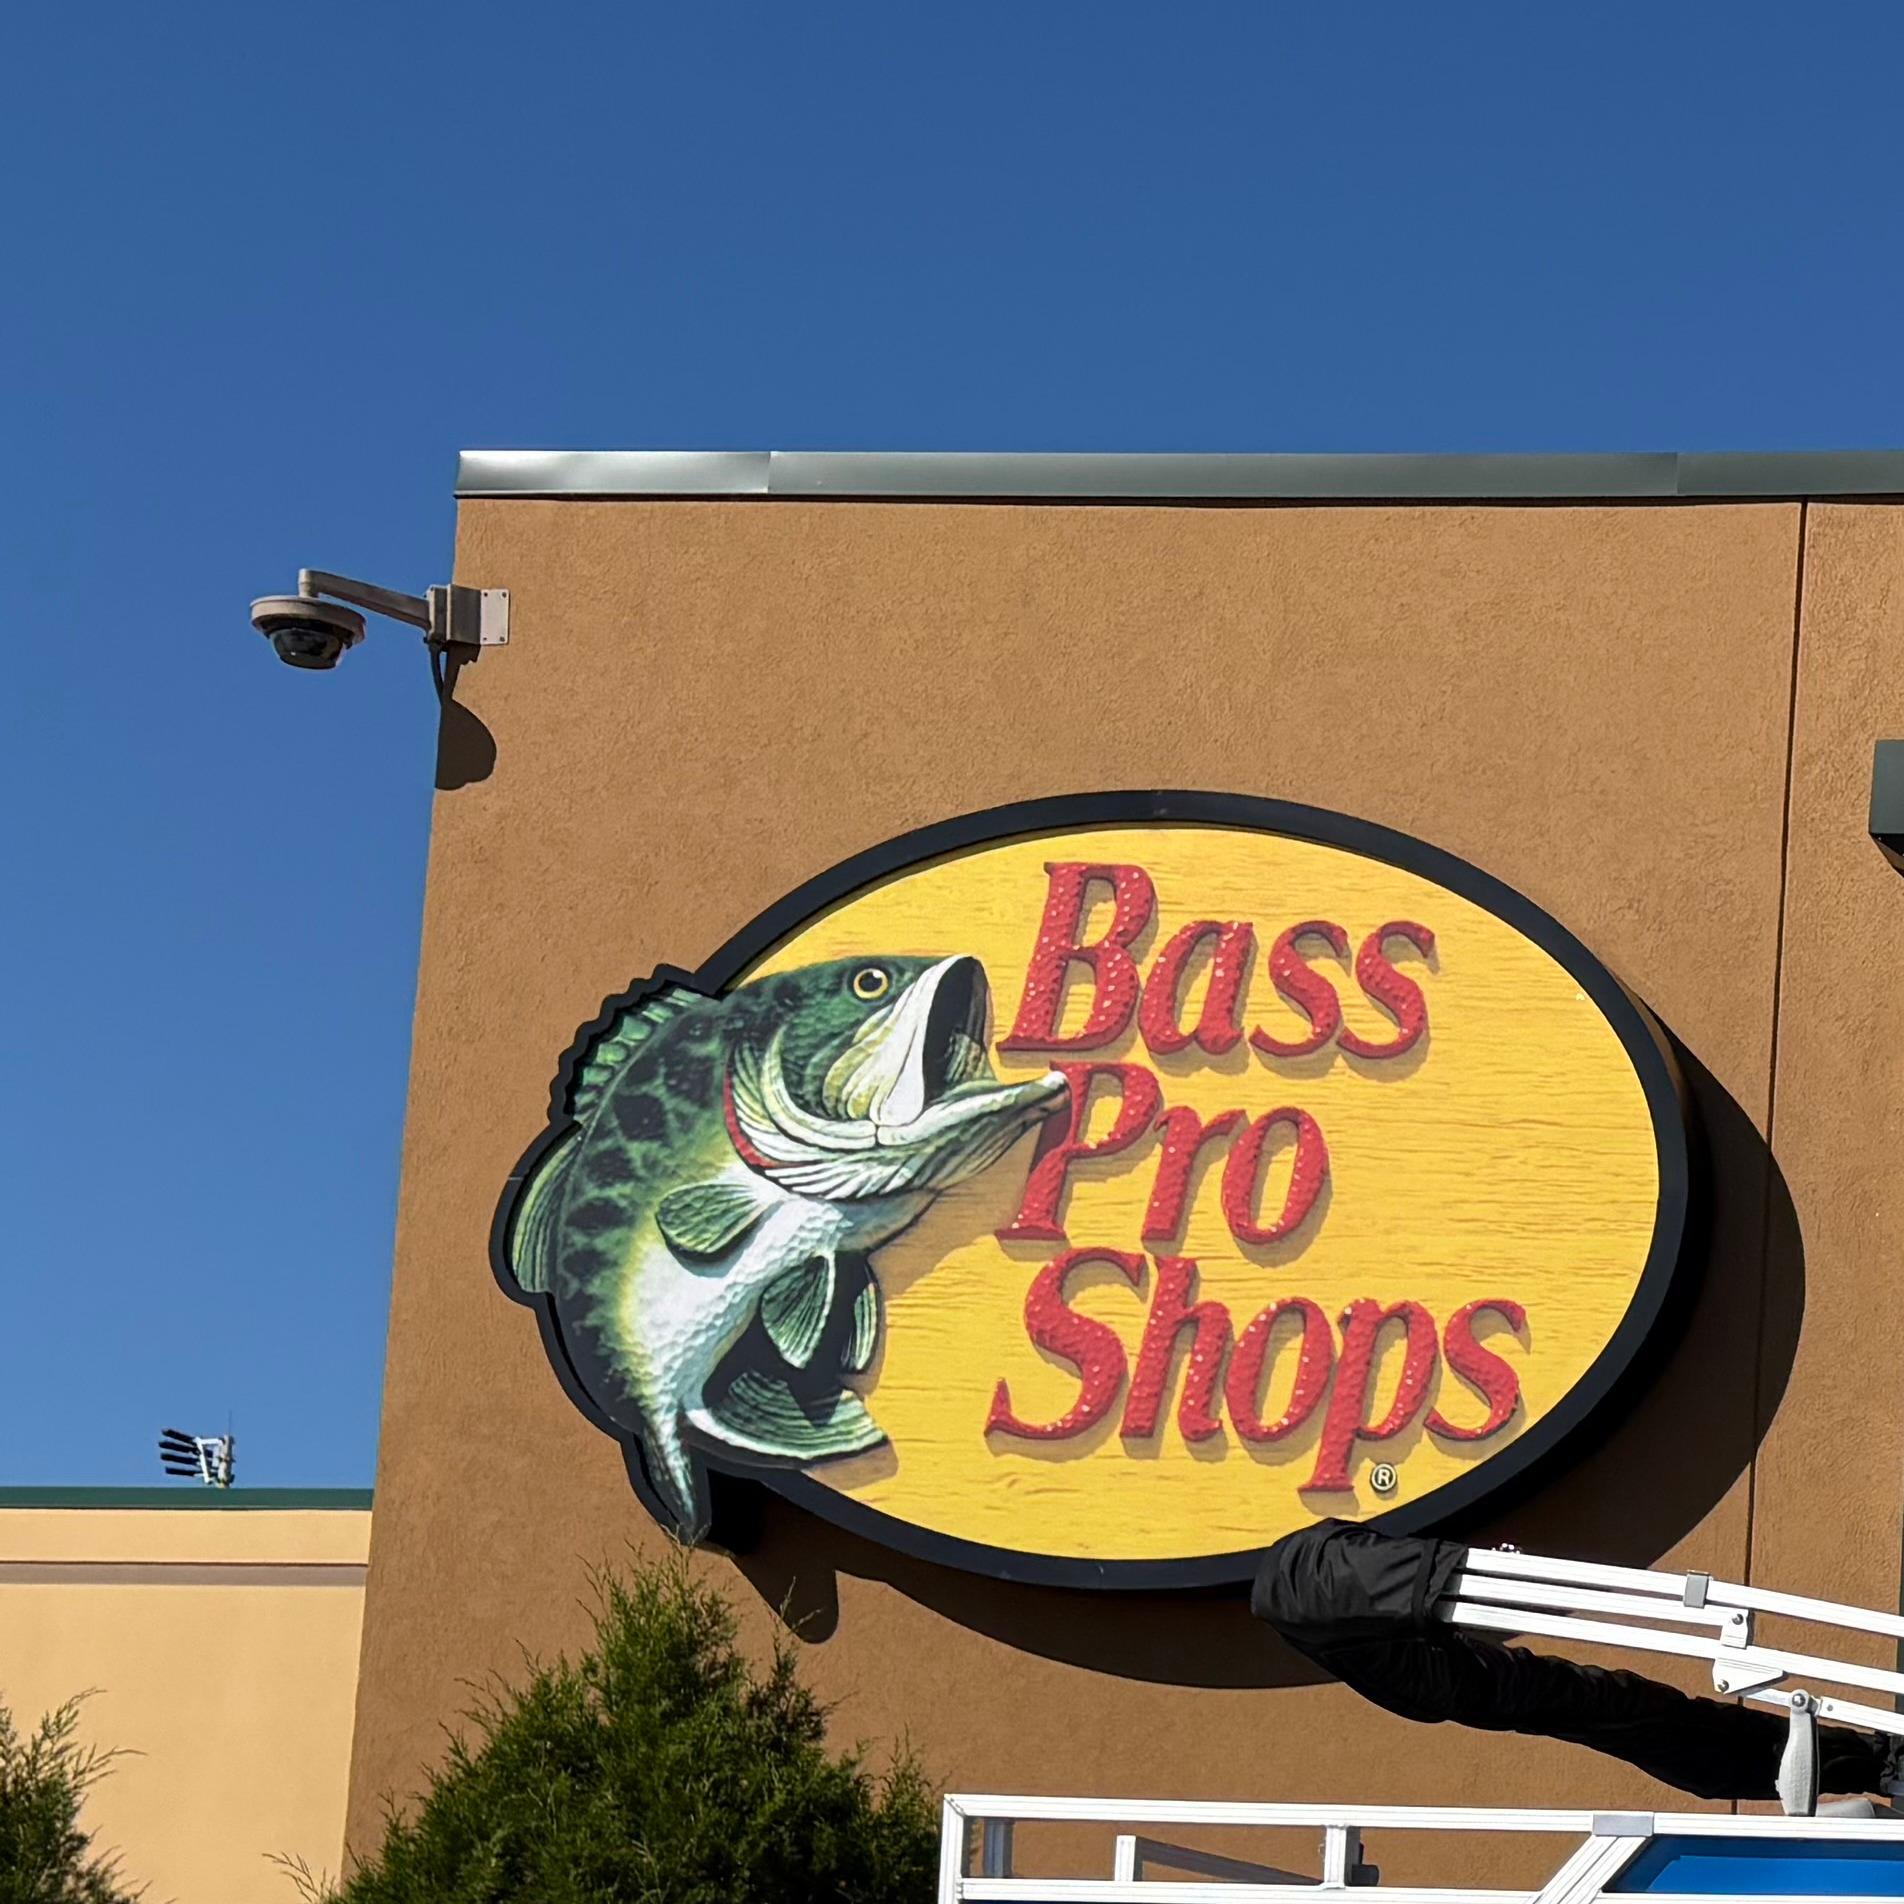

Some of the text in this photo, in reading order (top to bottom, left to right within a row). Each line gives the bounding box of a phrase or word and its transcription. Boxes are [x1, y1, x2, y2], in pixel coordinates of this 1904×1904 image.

[994, 860, 1436, 1060] Bass
[994, 1059, 1331, 1246] Pro
[984, 1246, 1528, 1493] Shops
